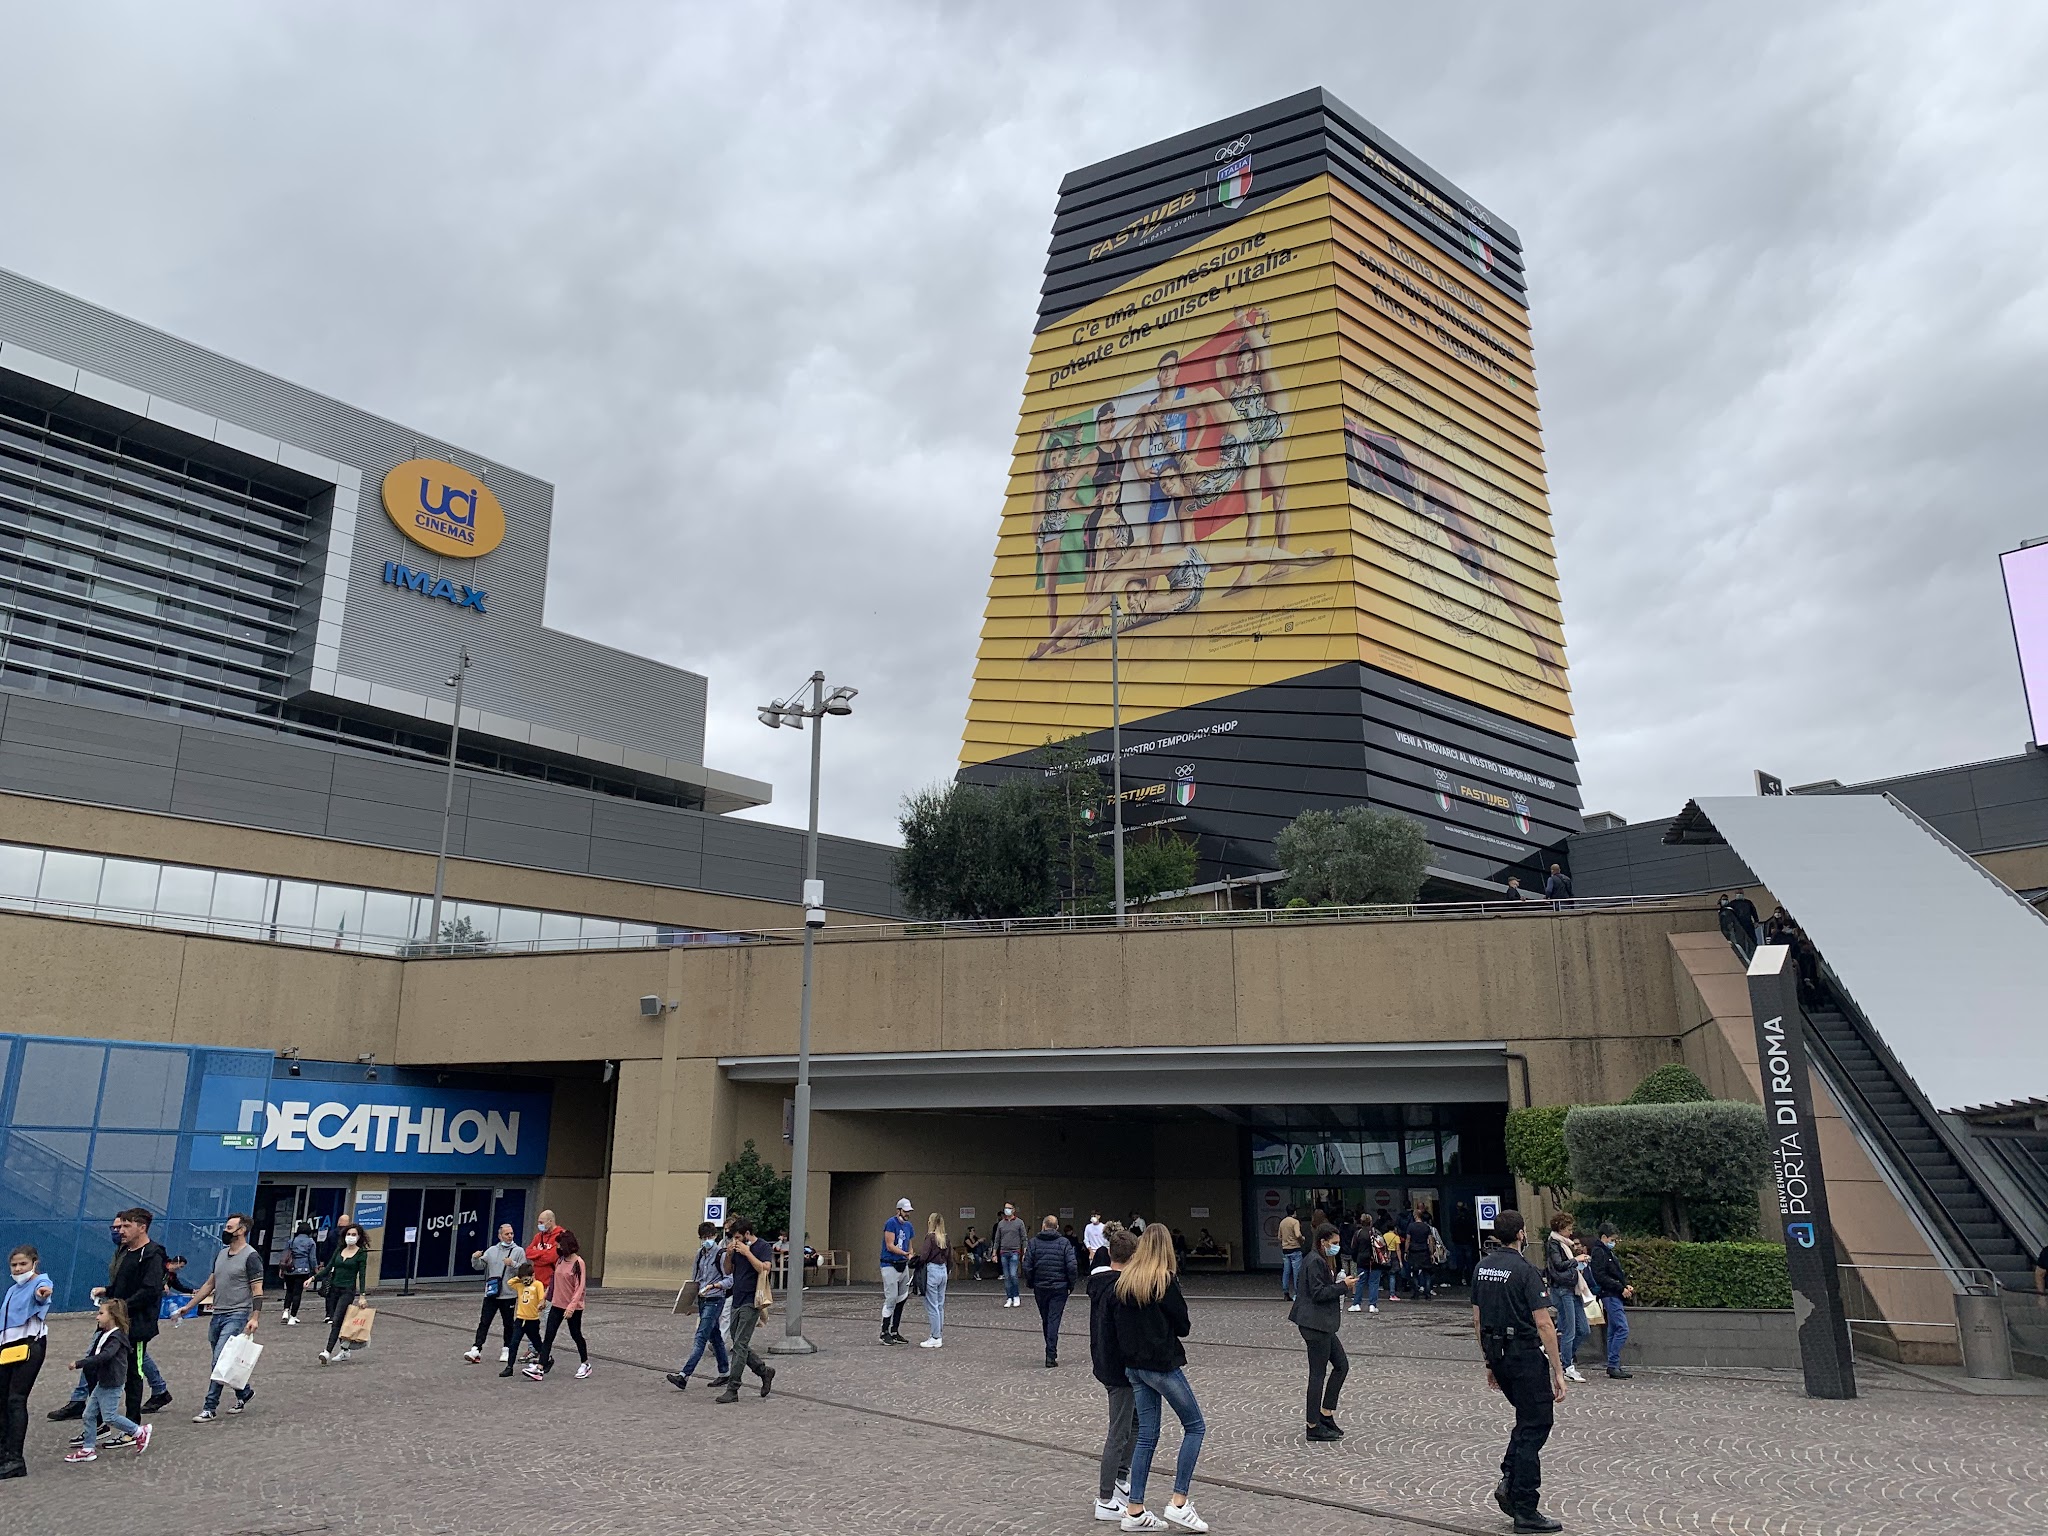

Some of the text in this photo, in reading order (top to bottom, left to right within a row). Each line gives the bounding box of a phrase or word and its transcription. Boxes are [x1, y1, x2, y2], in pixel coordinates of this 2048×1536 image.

[1219, 158, 1249, 179] ITALIA
[1363, 145, 1455, 223] FASTWEB
[1088, 188, 1198, 262] FASTWEB
[1073, 231, 1267, 346] C'è una connessione
[1371, 283, 1405, 319] fino
[1387, 236, 1486, 315] Roma naviga
[1357, 250, 1517, 362] con Fibra Ultraveloce
[1049, 341, 1115, 389] potente
[1119, 319, 1152, 348] che
[1155, 284, 1221, 330] unisce
[415, 513, 475, 544] CINEMAS
[383, 560, 487, 614] IMAX
[1121, 741, 1156, 759] NOSTRO
[1157, 725, 1212, 749] TEMPORARY
[1212, 719, 1239, 735] SHOP
[1395, 731, 1556, 791] VIENI A TROVARCI AL NOSTRO TEMPORARY SHOP
[1460, 785, 1510, 808] FASTWEB
[235, 1099, 521, 1156] DECATHLON
[1763, 1016, 1812, 1216] PORTA DI ROMA
[1772, 1149, 1789, 1215] BENVENUTI A
[427, 1209, 478, 1232] USCITA
[1478, 1267, 1512, 1280] Battistolli
